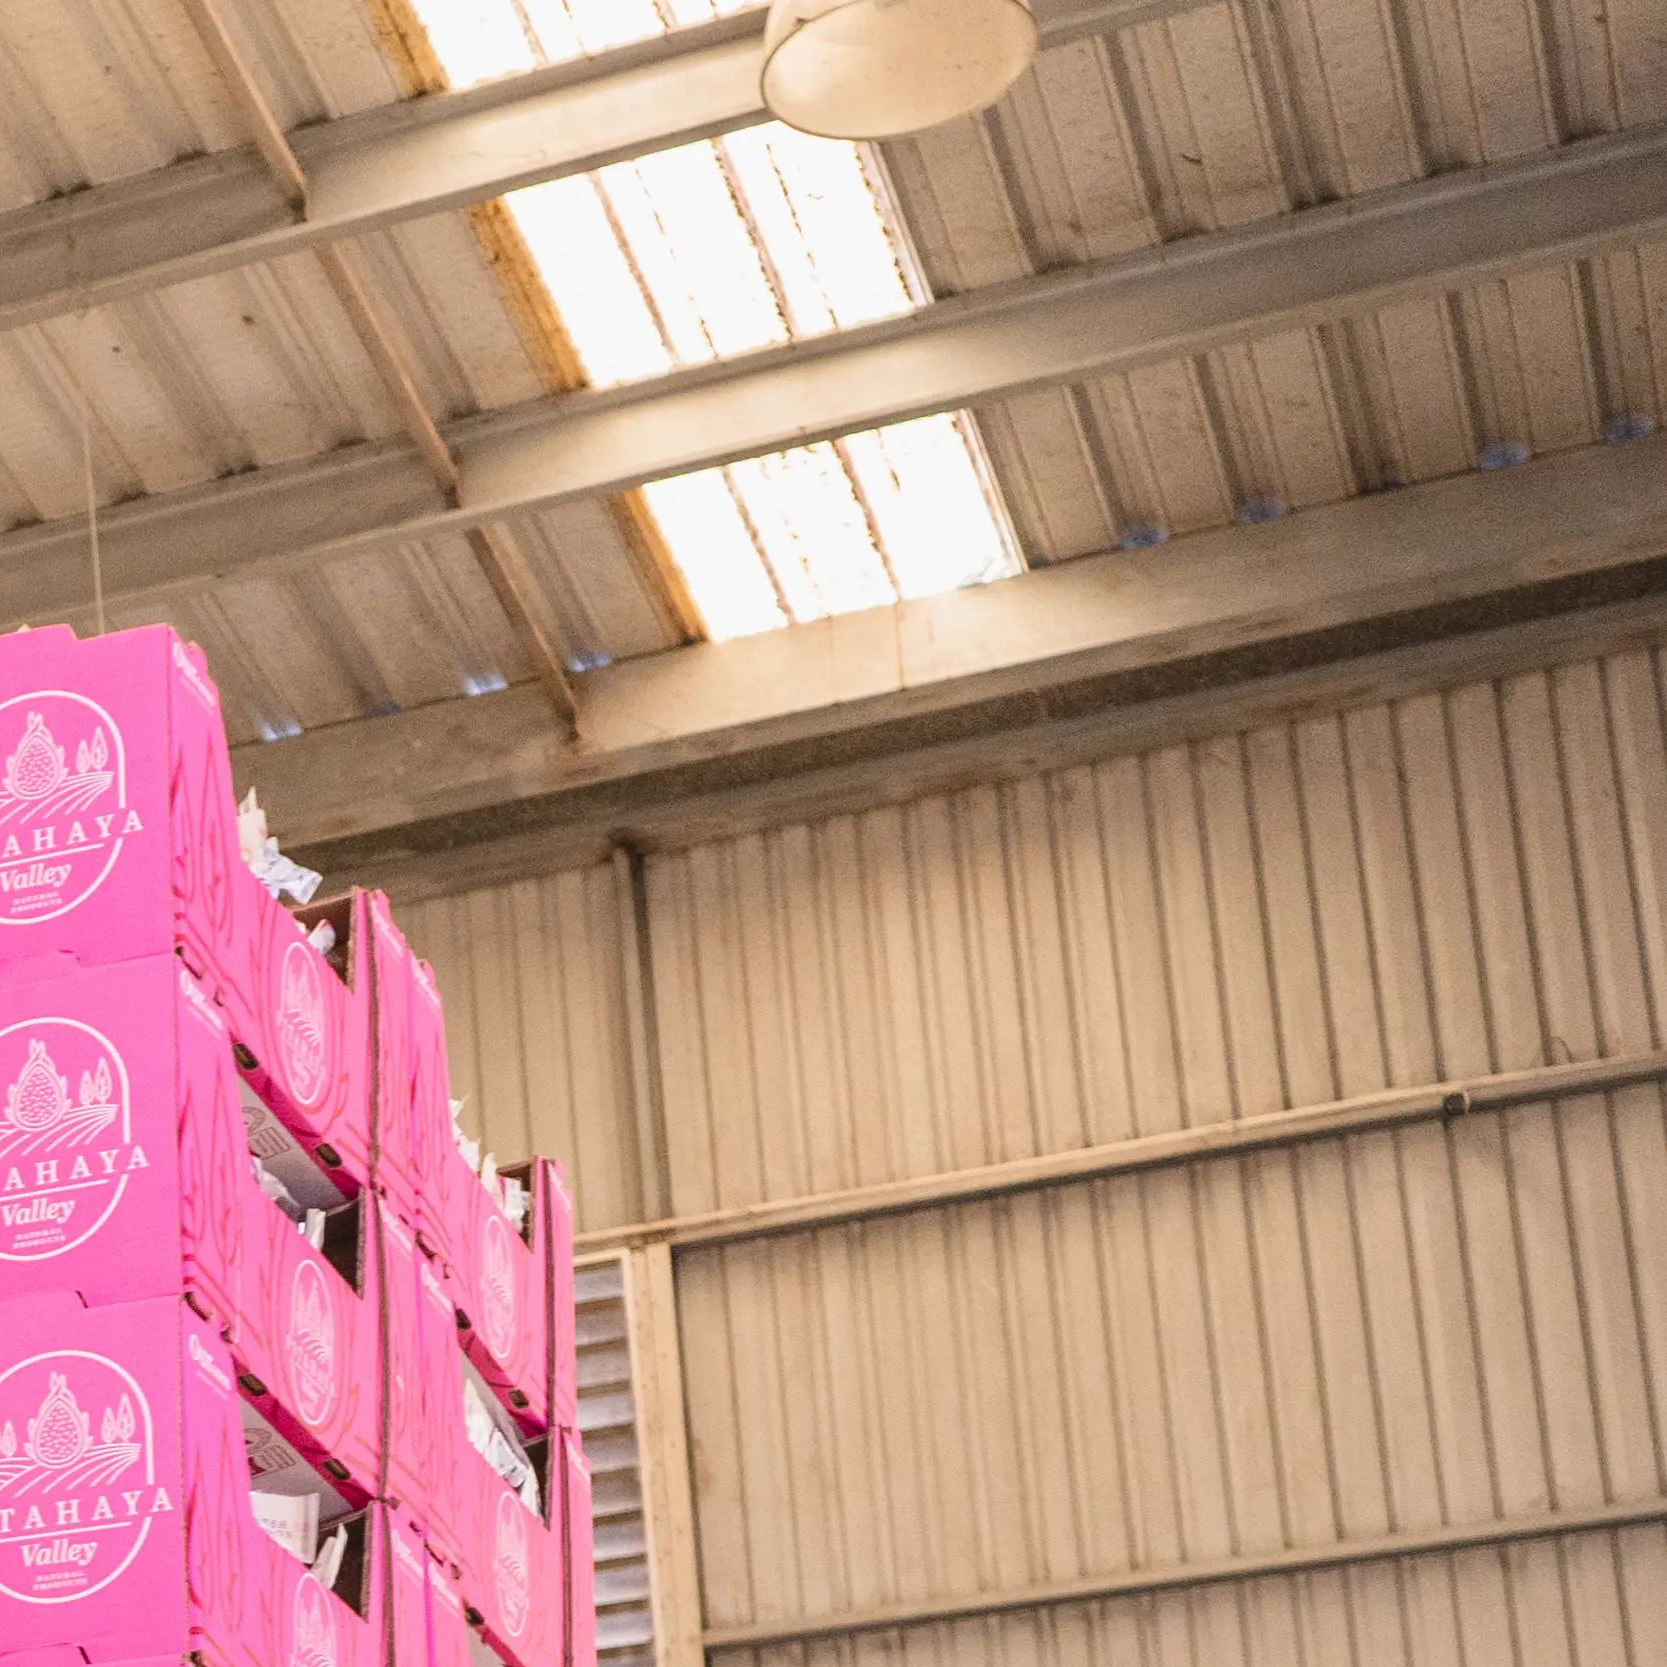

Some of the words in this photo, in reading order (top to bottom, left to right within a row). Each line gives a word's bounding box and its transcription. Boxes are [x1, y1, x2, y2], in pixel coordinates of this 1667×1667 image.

[0, 863, 72, 892] Valley
[1, 1198, 75, 1226] Valley
[21, 1538, 98, 1567] Valley
